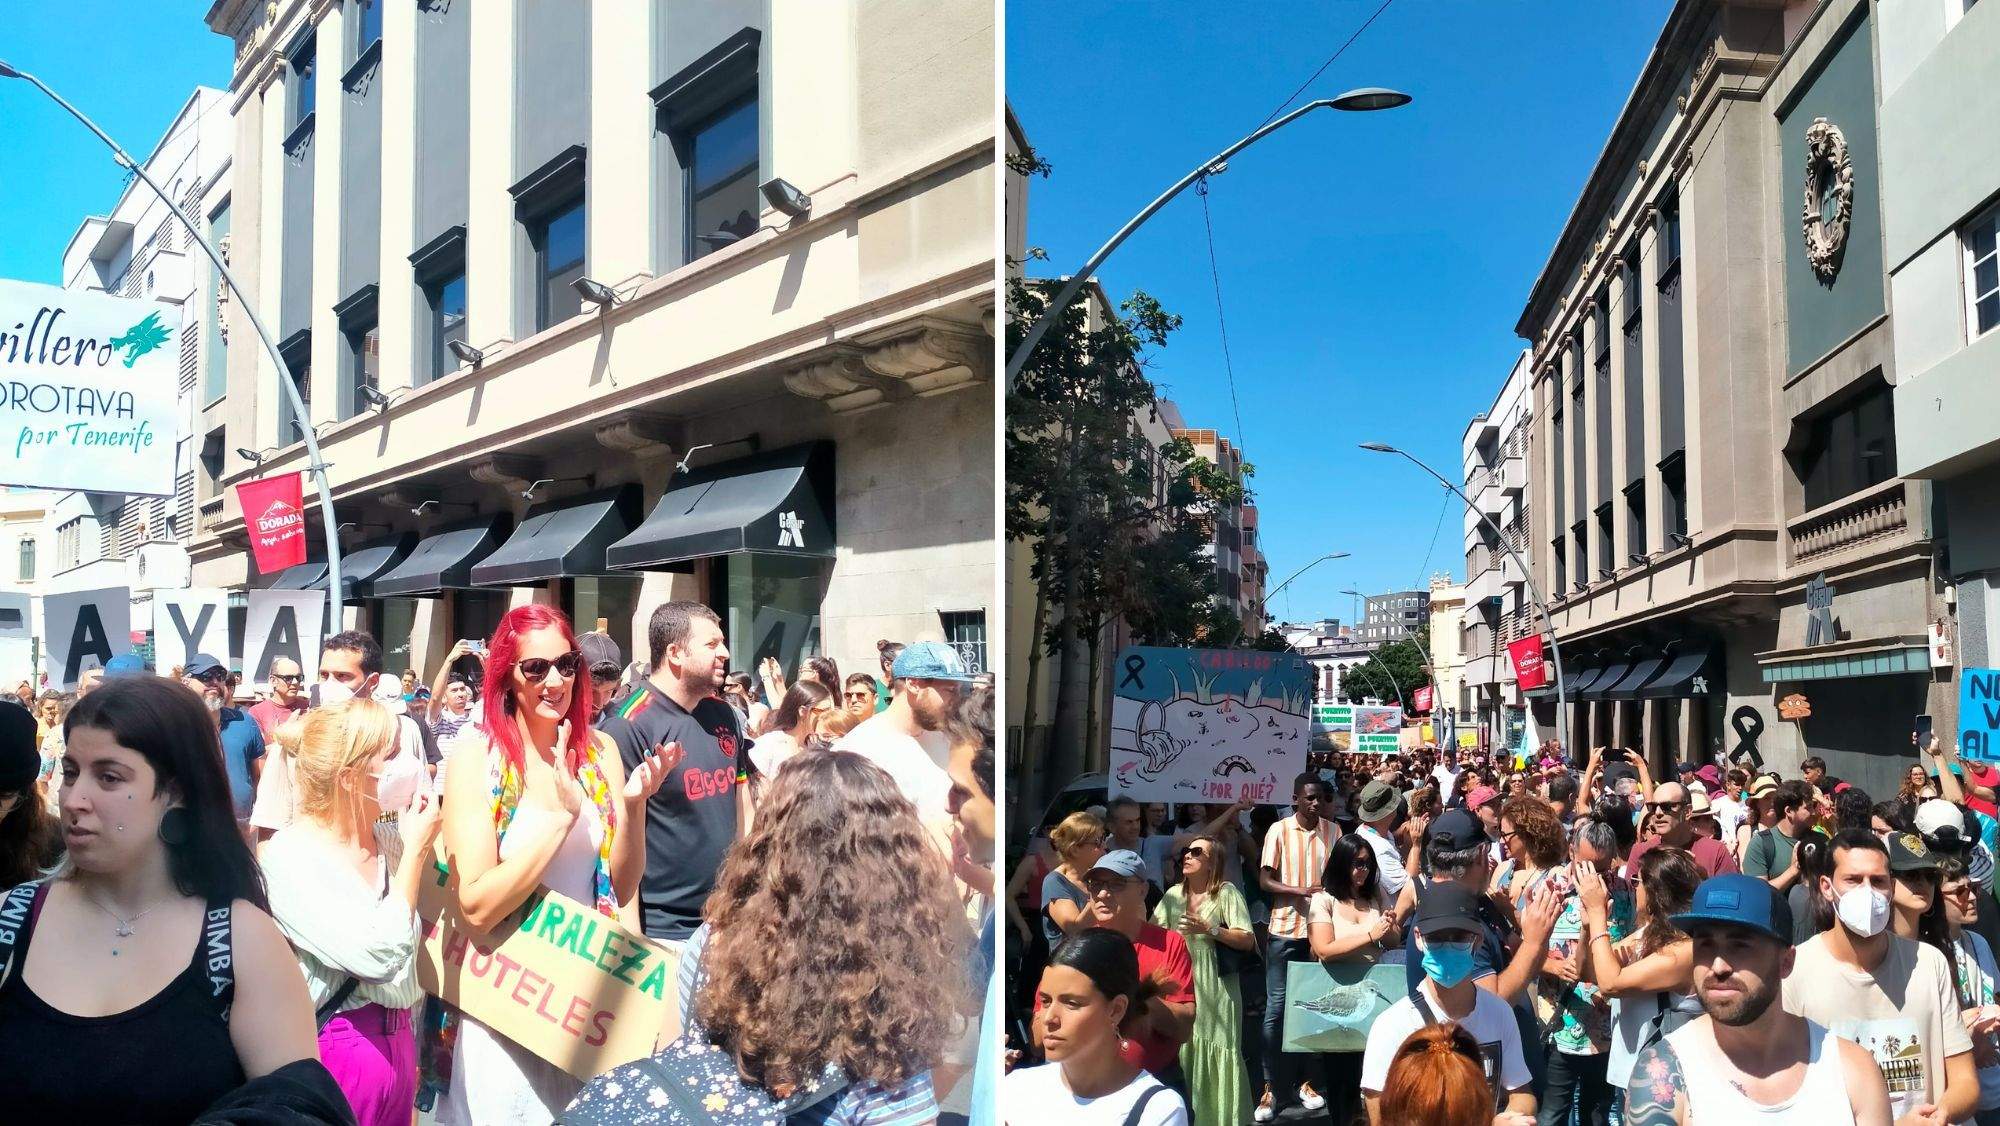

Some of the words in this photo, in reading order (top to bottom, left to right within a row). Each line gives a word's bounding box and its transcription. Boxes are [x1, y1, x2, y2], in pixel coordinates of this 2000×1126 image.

[0, 381, 134, 419] ROTAVA
[16, 425, 58, 459] por
[66, 420, 153, 453] Tenerife
[259, 512, 303, 532] DORADA
[1202, 779, 1233, 799] ¿POR
[1241, 777, 1274, 802] QUÉ?
[207, 907, 233, 997] BIMBA
[519, 892, 666, 1001] URALEZA
[443, 930, 616, 1047] HOTELES
